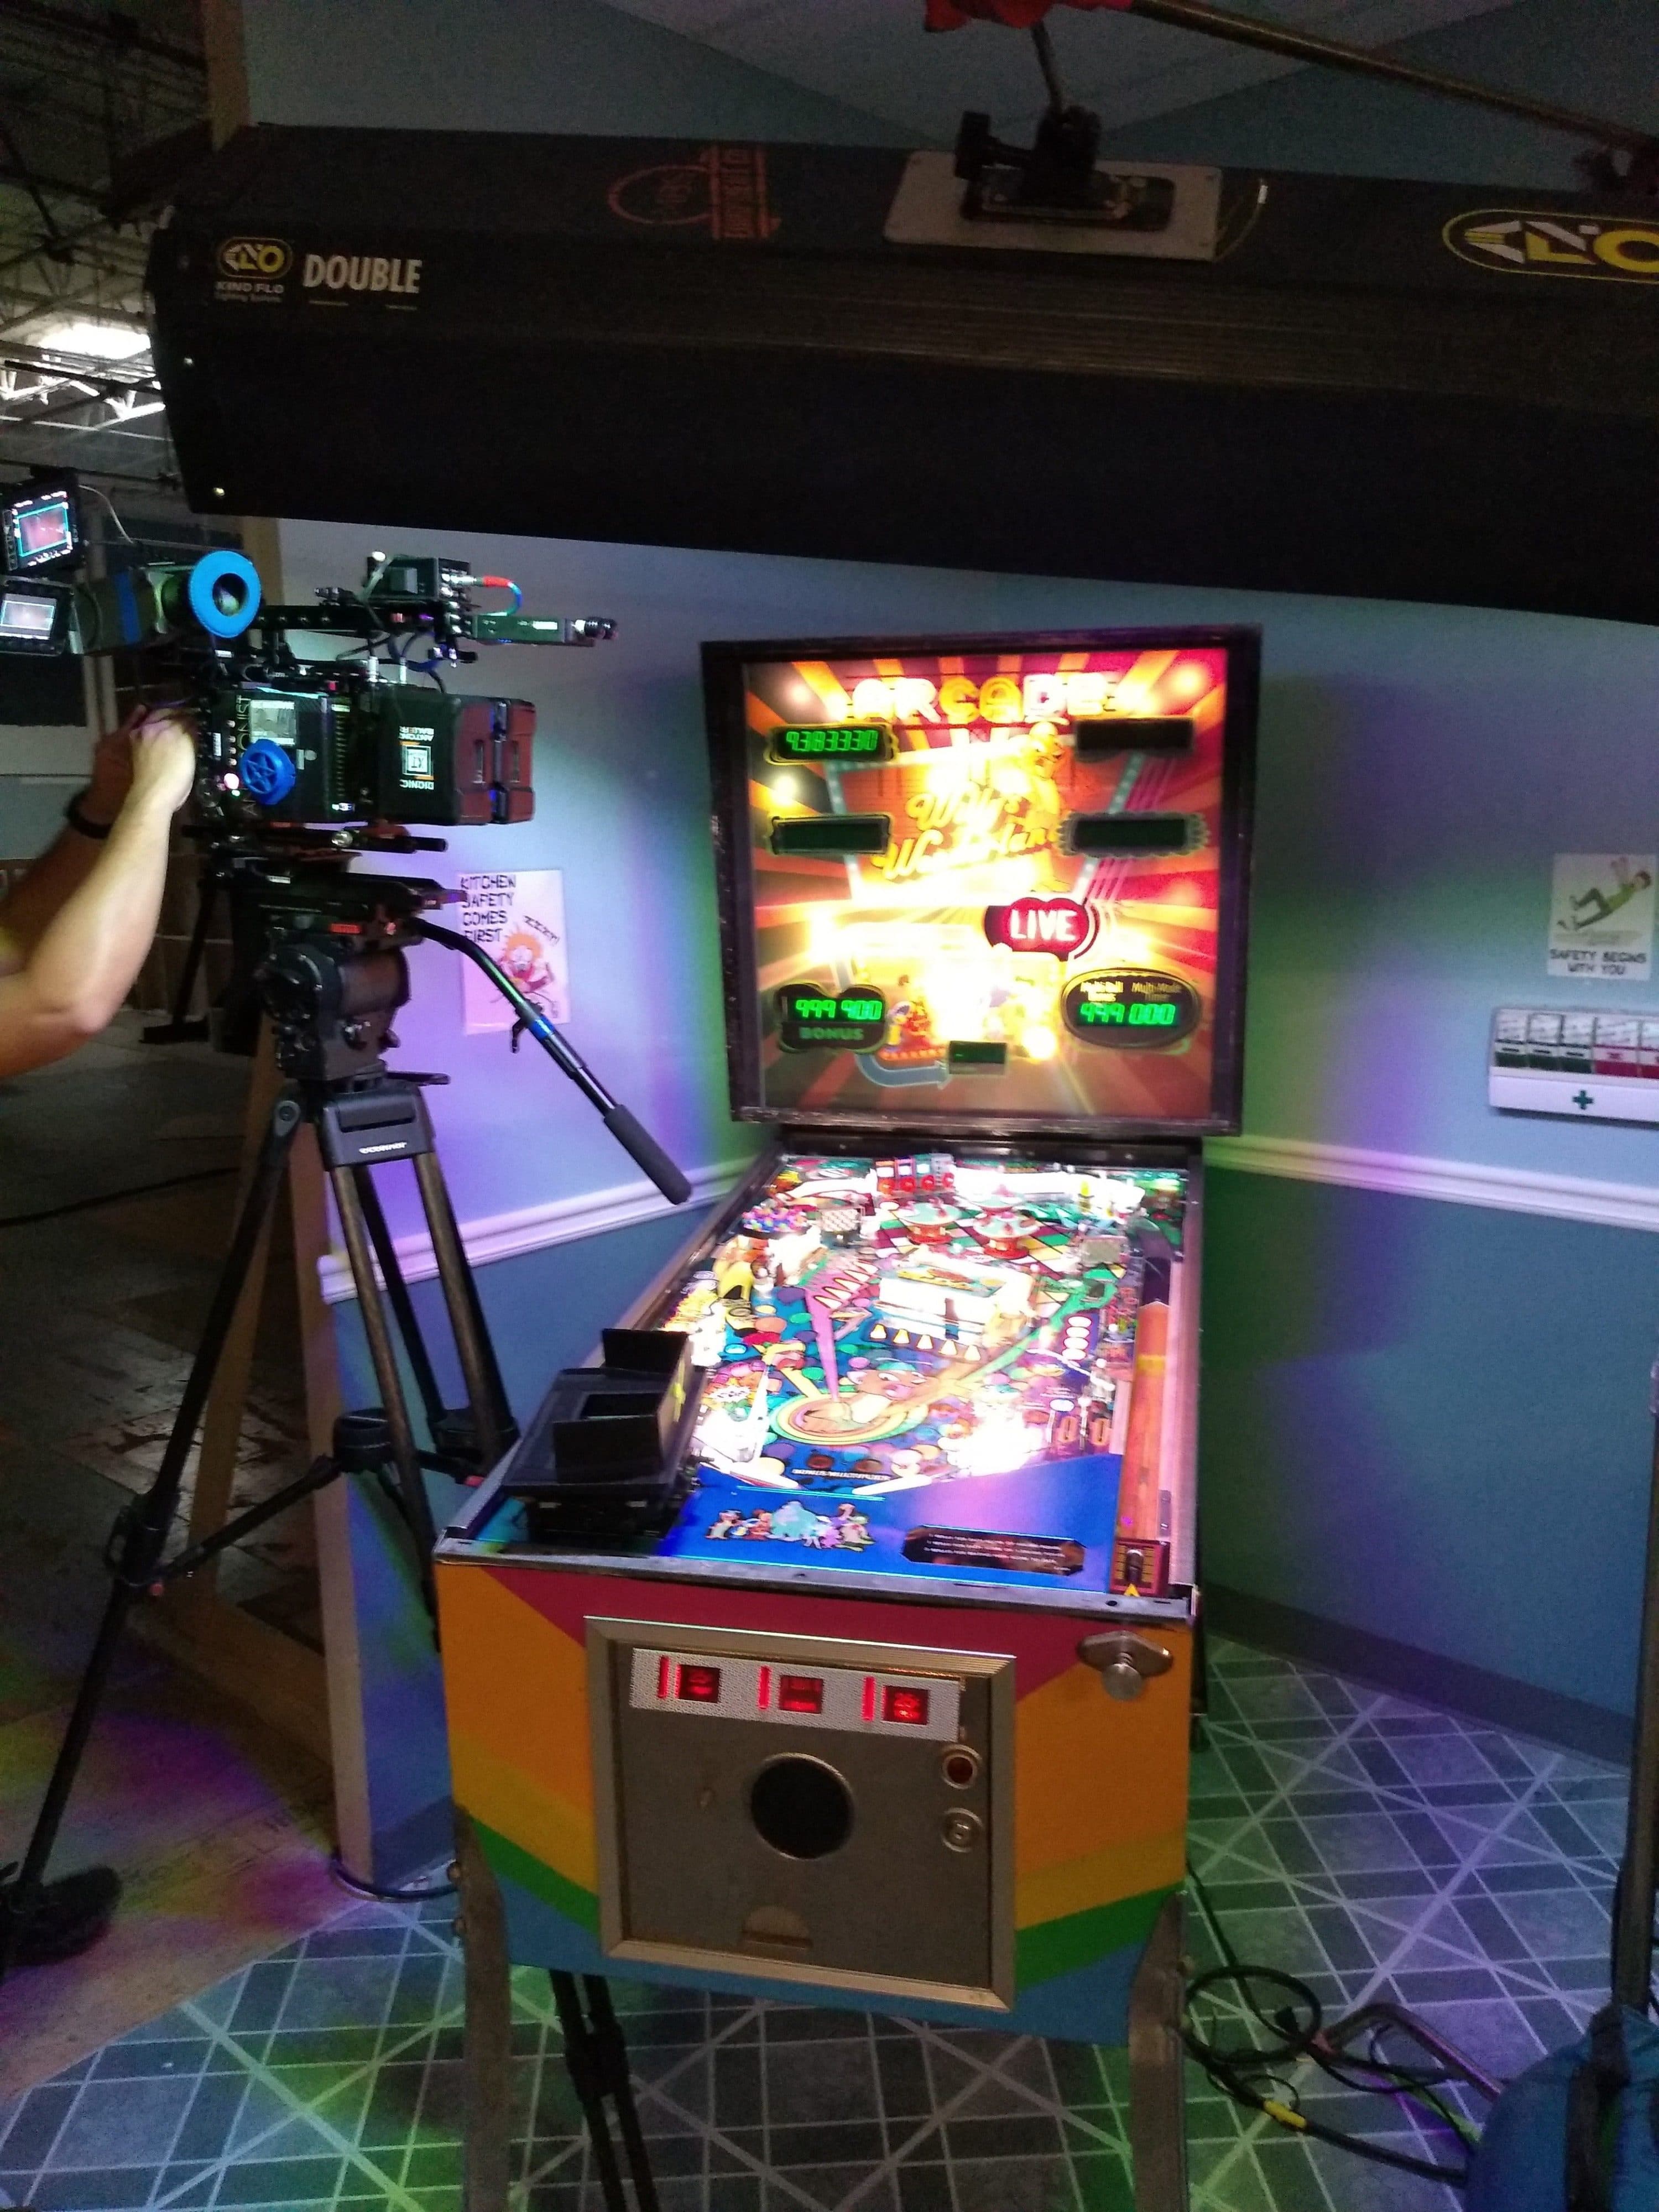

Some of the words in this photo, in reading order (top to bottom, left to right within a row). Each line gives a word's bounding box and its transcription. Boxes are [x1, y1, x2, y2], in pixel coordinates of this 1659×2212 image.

[302, 253, 422, 293] DOUBLE
[399, 779, 434, 790] DIONIC
[461, 874, 516, 890] KITCHEN
[463, 910, 508, 926] COMES
[1010, 909, 1077, 942] LIVE
[465, 928, 503, 942] FIRST
[799, 1026, 864, 1040] BONUS
